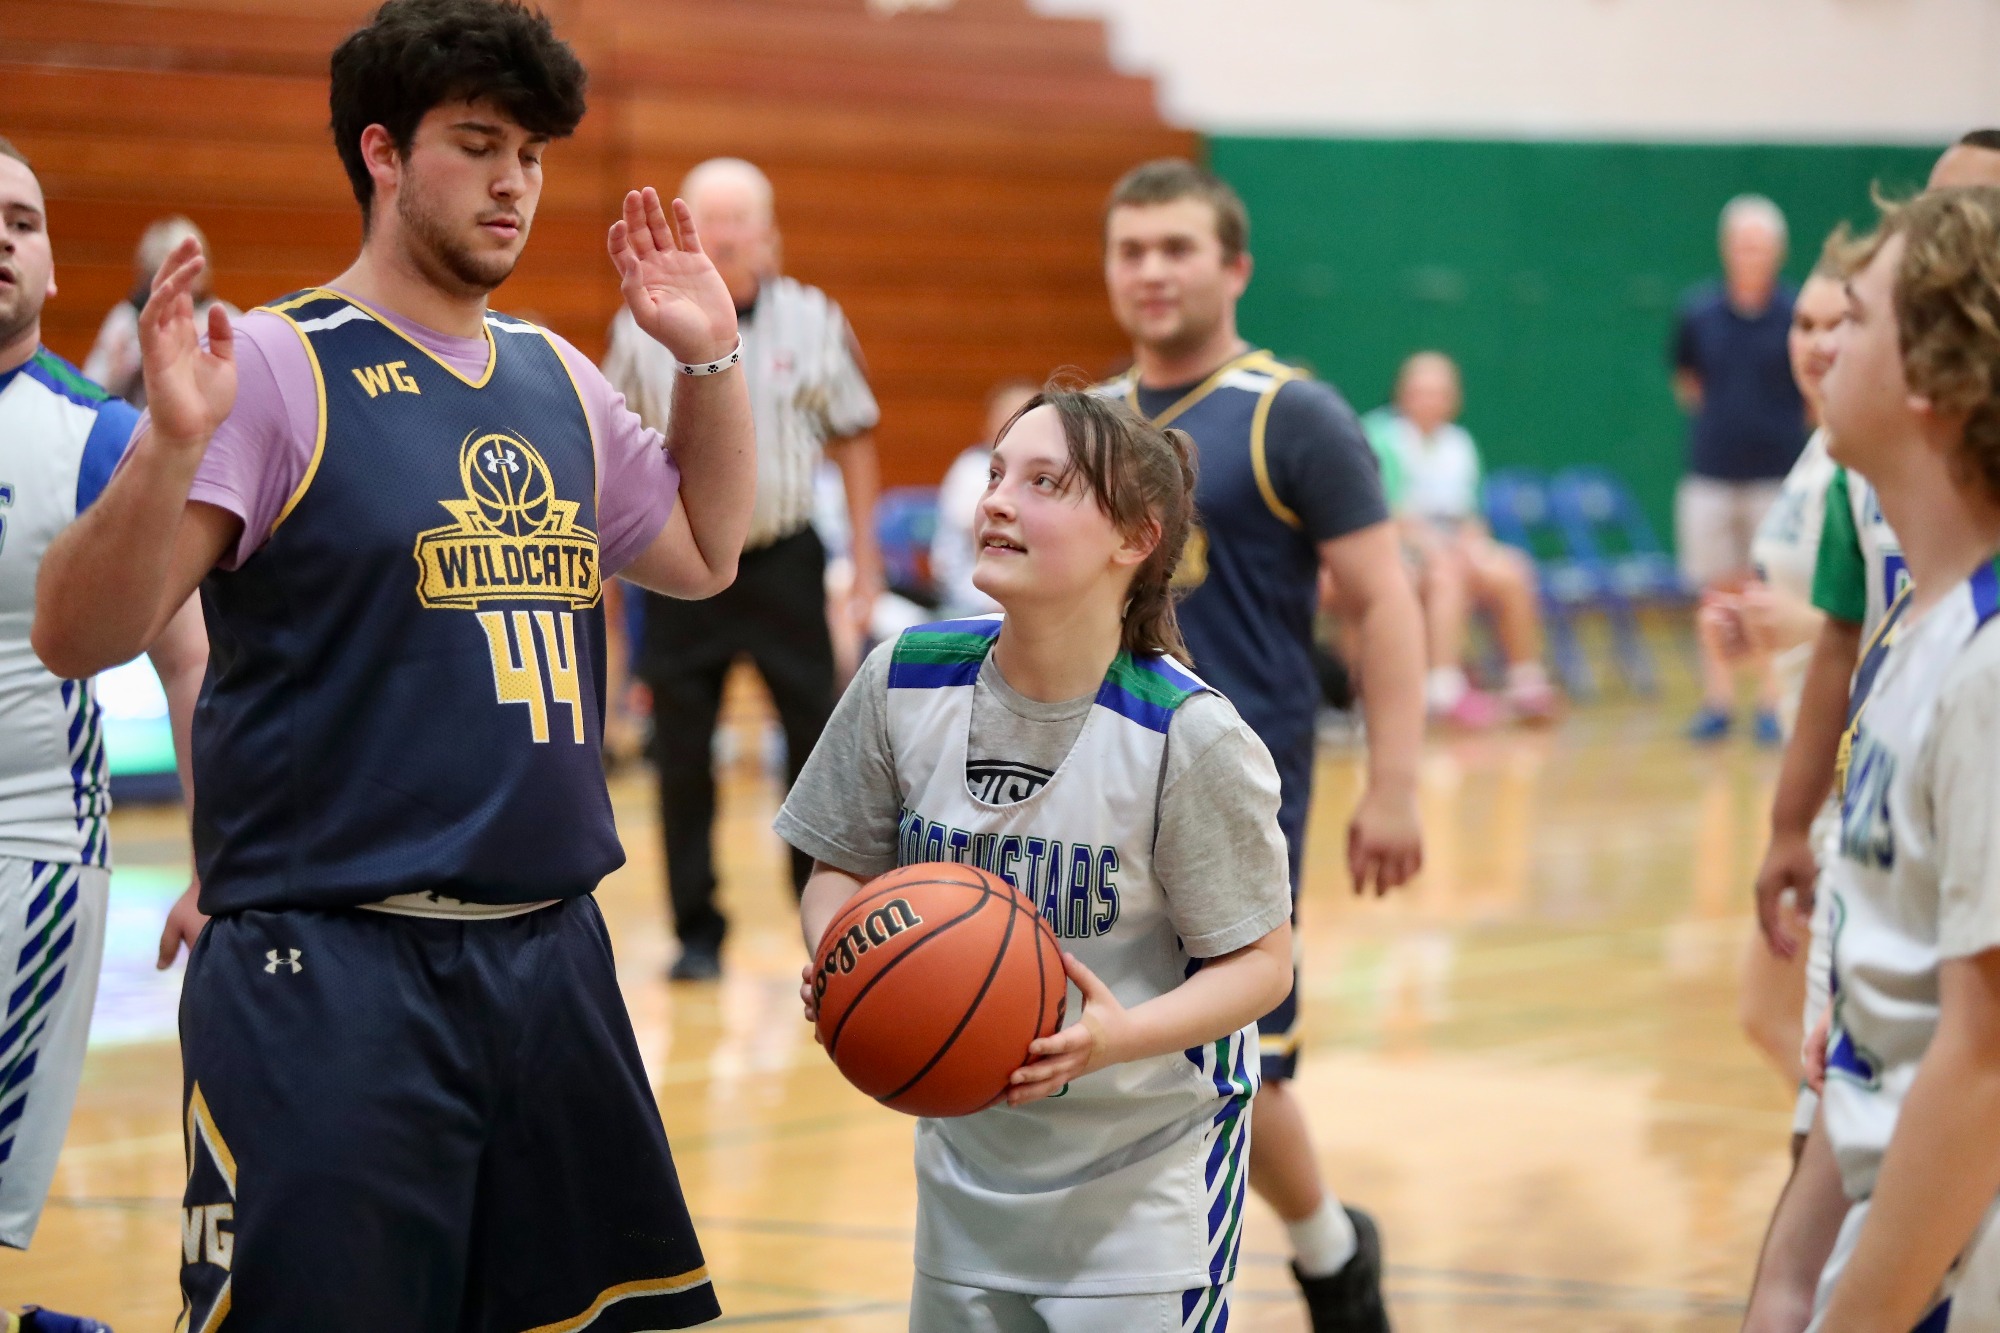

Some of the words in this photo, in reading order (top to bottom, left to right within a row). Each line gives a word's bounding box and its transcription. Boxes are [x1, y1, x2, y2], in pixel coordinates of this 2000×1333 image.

[351, 360, 422, 399] WG
[435, 544, 594, 590] WILDCATS
[474, 610, 585, 745] 44
[812, 897, 924, 1010] Wilso
